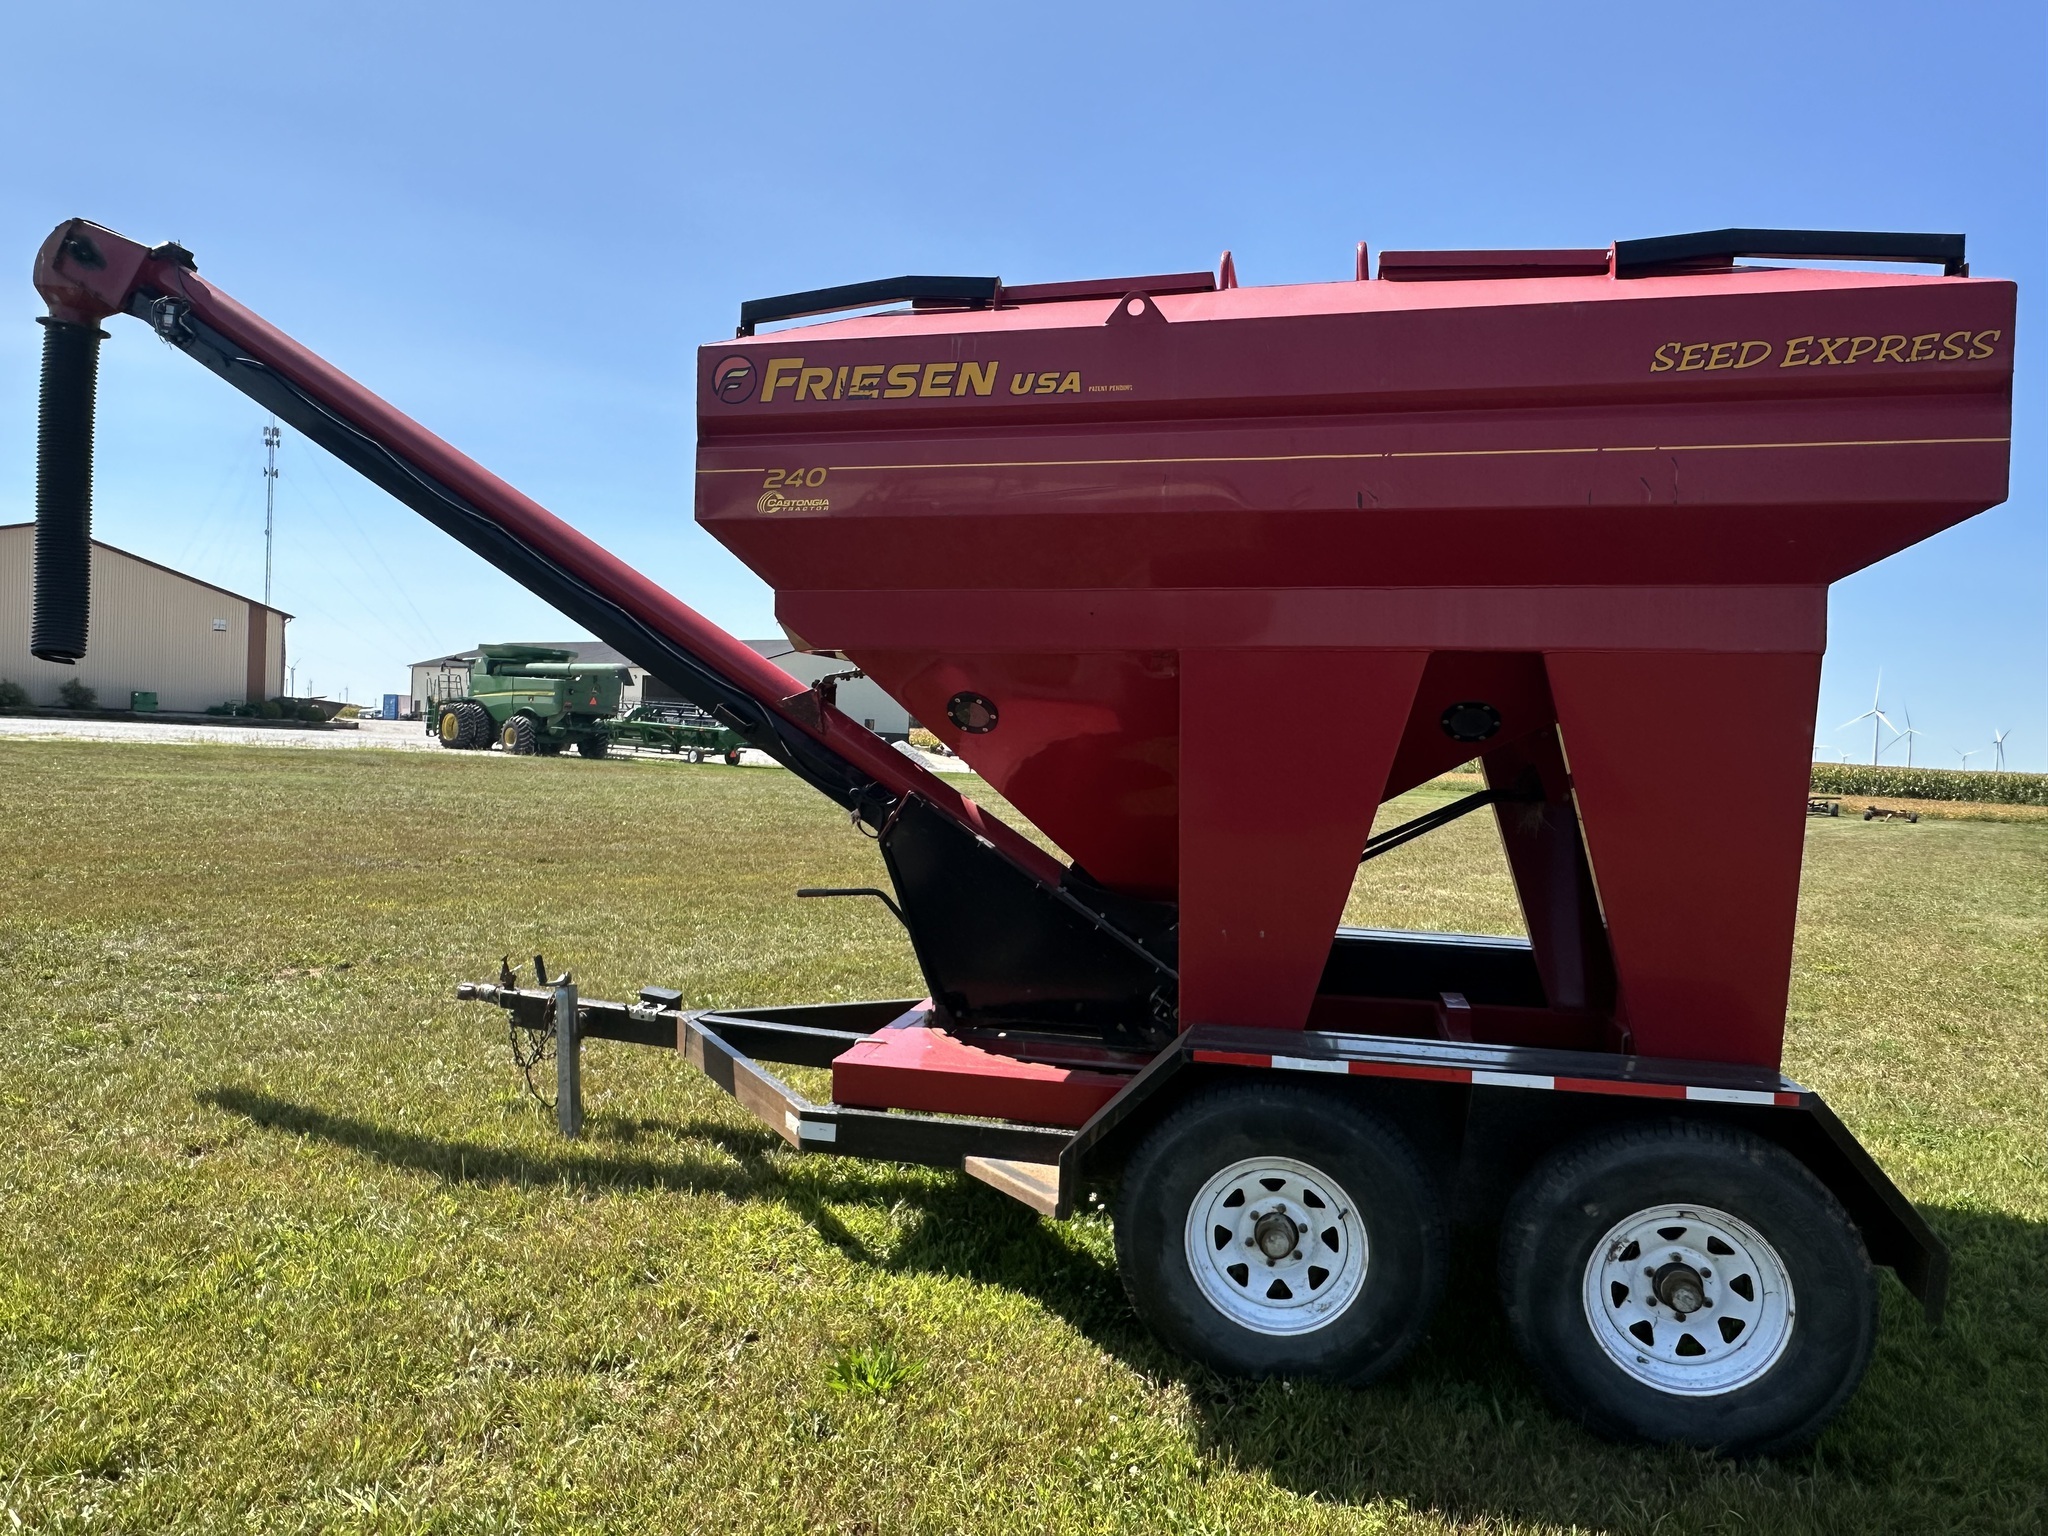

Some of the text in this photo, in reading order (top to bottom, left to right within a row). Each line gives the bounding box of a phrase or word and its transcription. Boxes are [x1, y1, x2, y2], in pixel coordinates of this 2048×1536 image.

[1649, 329, 2001, 373] SEED EXPRESS
[759, 358, 1081, 402] FRIESEN USA
[763, 467, 827, 488] 240
[767, 499, 829, 507] CASTONGIA
